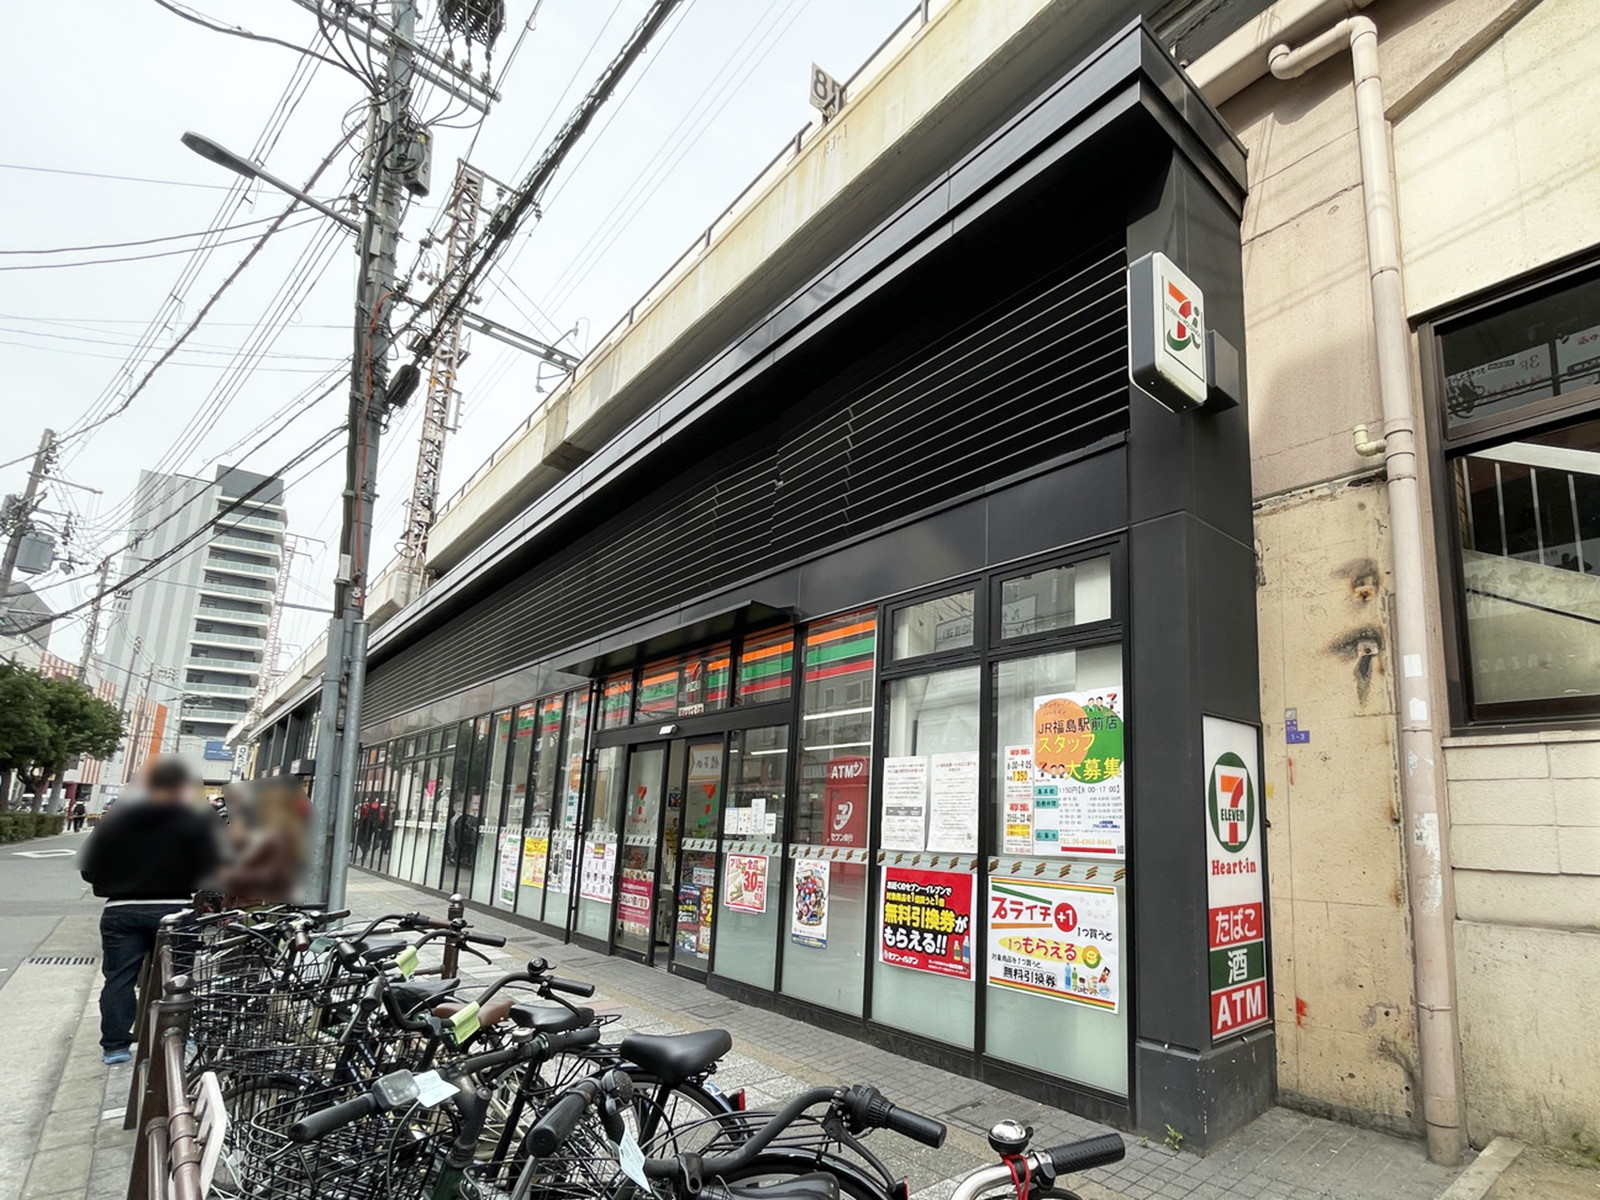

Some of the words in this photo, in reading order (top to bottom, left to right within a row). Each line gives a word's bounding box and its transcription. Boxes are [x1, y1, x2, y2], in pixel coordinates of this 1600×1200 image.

[1038, 715, 1118, 735] JR福島駅前店
[1037, 733, 1096, 754] スタッフ
[831, 765, 854, 779] ATM
[1065, 757, 1120, 781] 大募集
[884, 903, 969, 933] 無料引換券が
[1216, 907, 1256, 943] たばこ
[1077, 926, 1113, 942] 1つ買うと
[1008, 937, 1077, 961] 1つもらえる
[1003, 965, 1057, 988] 無料引換券
[1227, 948, 1247, 984] 酒
[1217, 985, 1262, 1030] ATM
